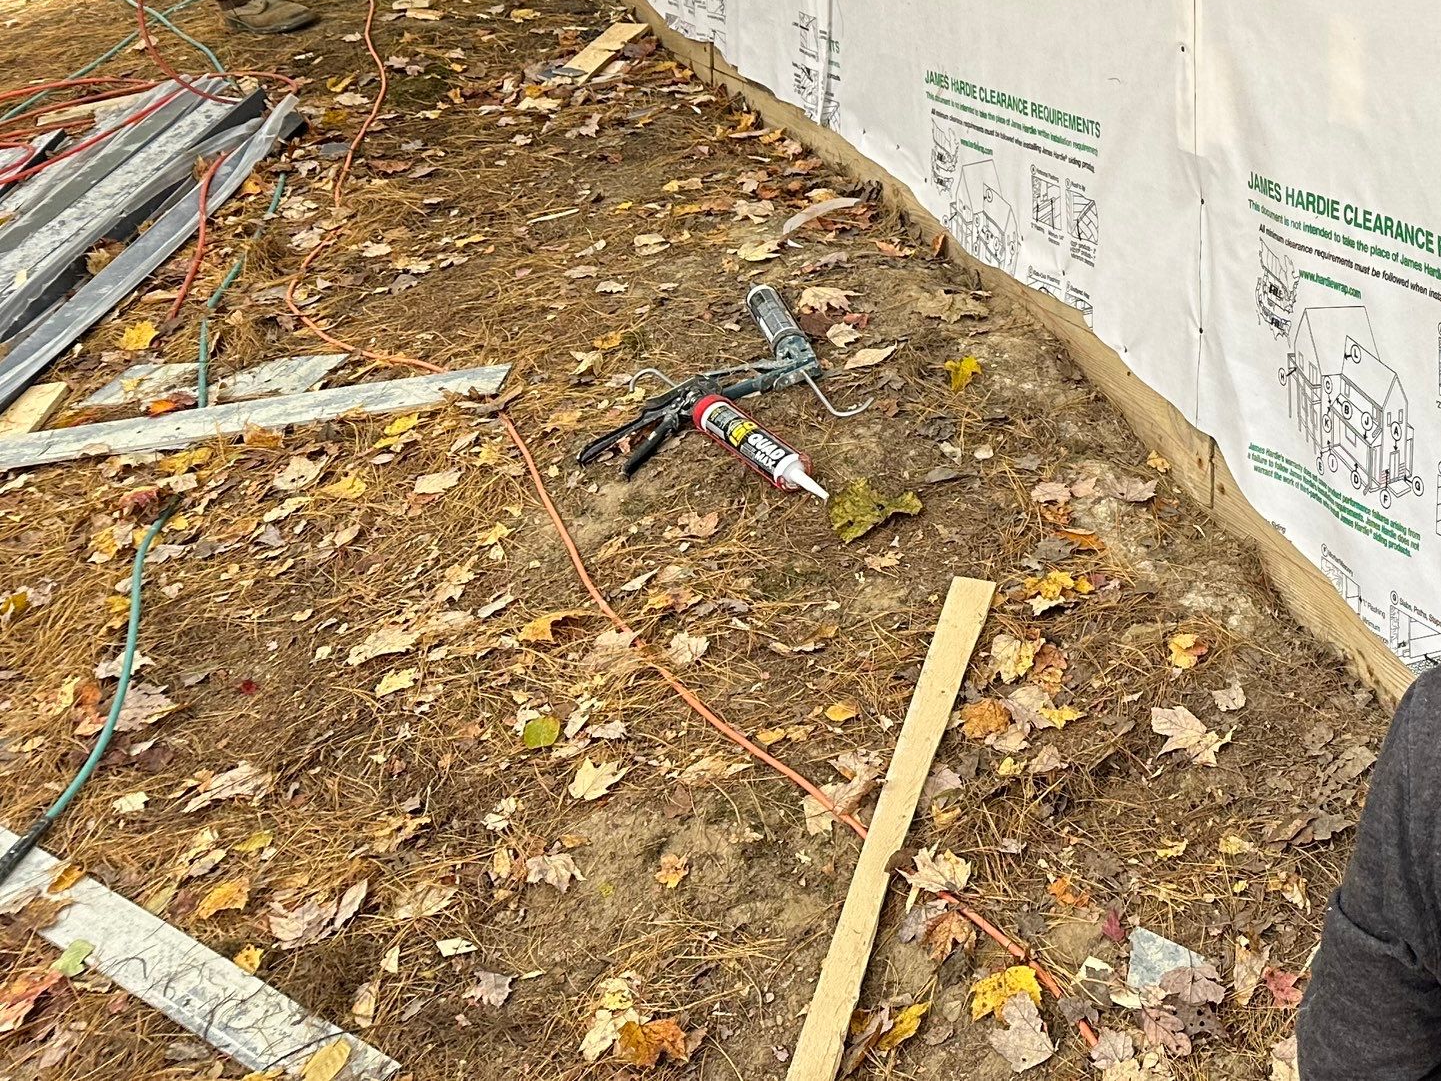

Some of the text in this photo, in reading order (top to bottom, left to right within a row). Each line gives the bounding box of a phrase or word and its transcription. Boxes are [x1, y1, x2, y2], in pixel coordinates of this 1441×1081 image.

[924, 69, 949, 90] JAMES
[951, 77, 977, 101] HARDIE
[979, 88, 1028, 117] CLEARANCE
[1031, 102, 1101, 139] REQUIREMENTS
[1247, 171, 1282, 203] JAMES
[1285, 186, 1340, 221] HARDIE
[1344, 203, 1434, 255] CLEARANCE
[1302, 222, 1332, 241] intended
[1334, 231, 1341, 243] to
[1356, 239, 1368, 253] the
[1370, 244, 1390, 261] place
[1391, 251, 1399, 262] of
[1400, 254, 1422, 271] James
[1314, 248, 1353, 269] requirements
[1354, 262, 1370, 275] must
[1371, 267, 1380, 278] be
[1382, 270, 1409, 289] followed
[1410, 279, 1427, 296] when
[748, 433, 786, 460] QUAD
[754, 451, 776, 470] MAX
